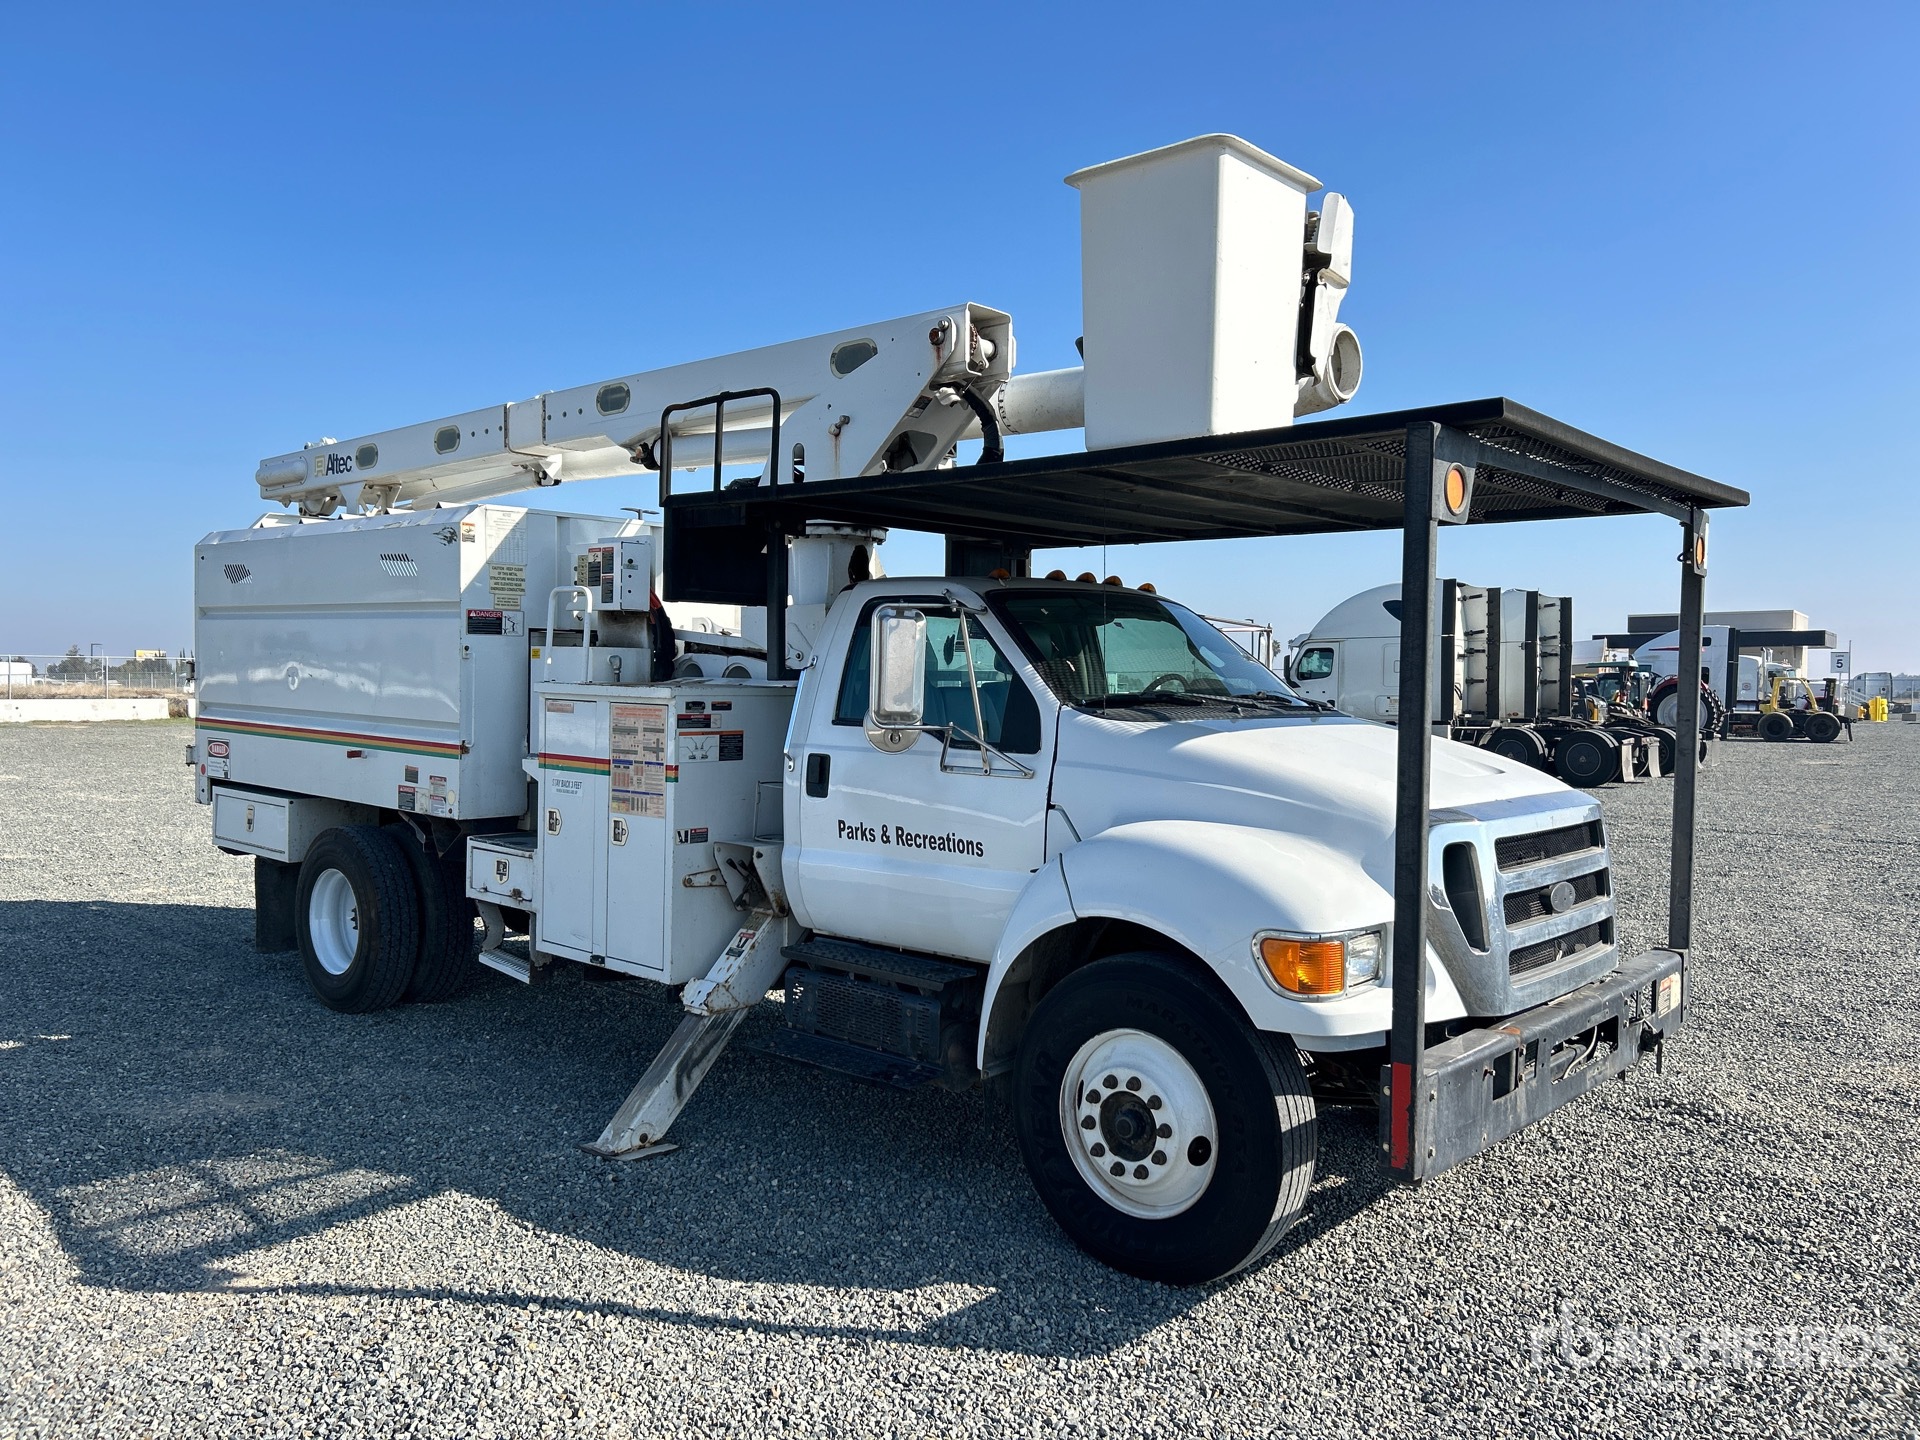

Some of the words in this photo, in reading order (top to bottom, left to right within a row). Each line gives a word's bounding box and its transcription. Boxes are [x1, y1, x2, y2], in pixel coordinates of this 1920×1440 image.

[326, 453, 352, 476] Altec
[1836, 659, 1843, 668] 5
[552, 779, 561, 787] STAY
[574, 781, 582, 789] FEET
[838, 819, 876, 843] Parks
[880, 824, 891, 845] &
[895, 826, 984, 858] Recreations
